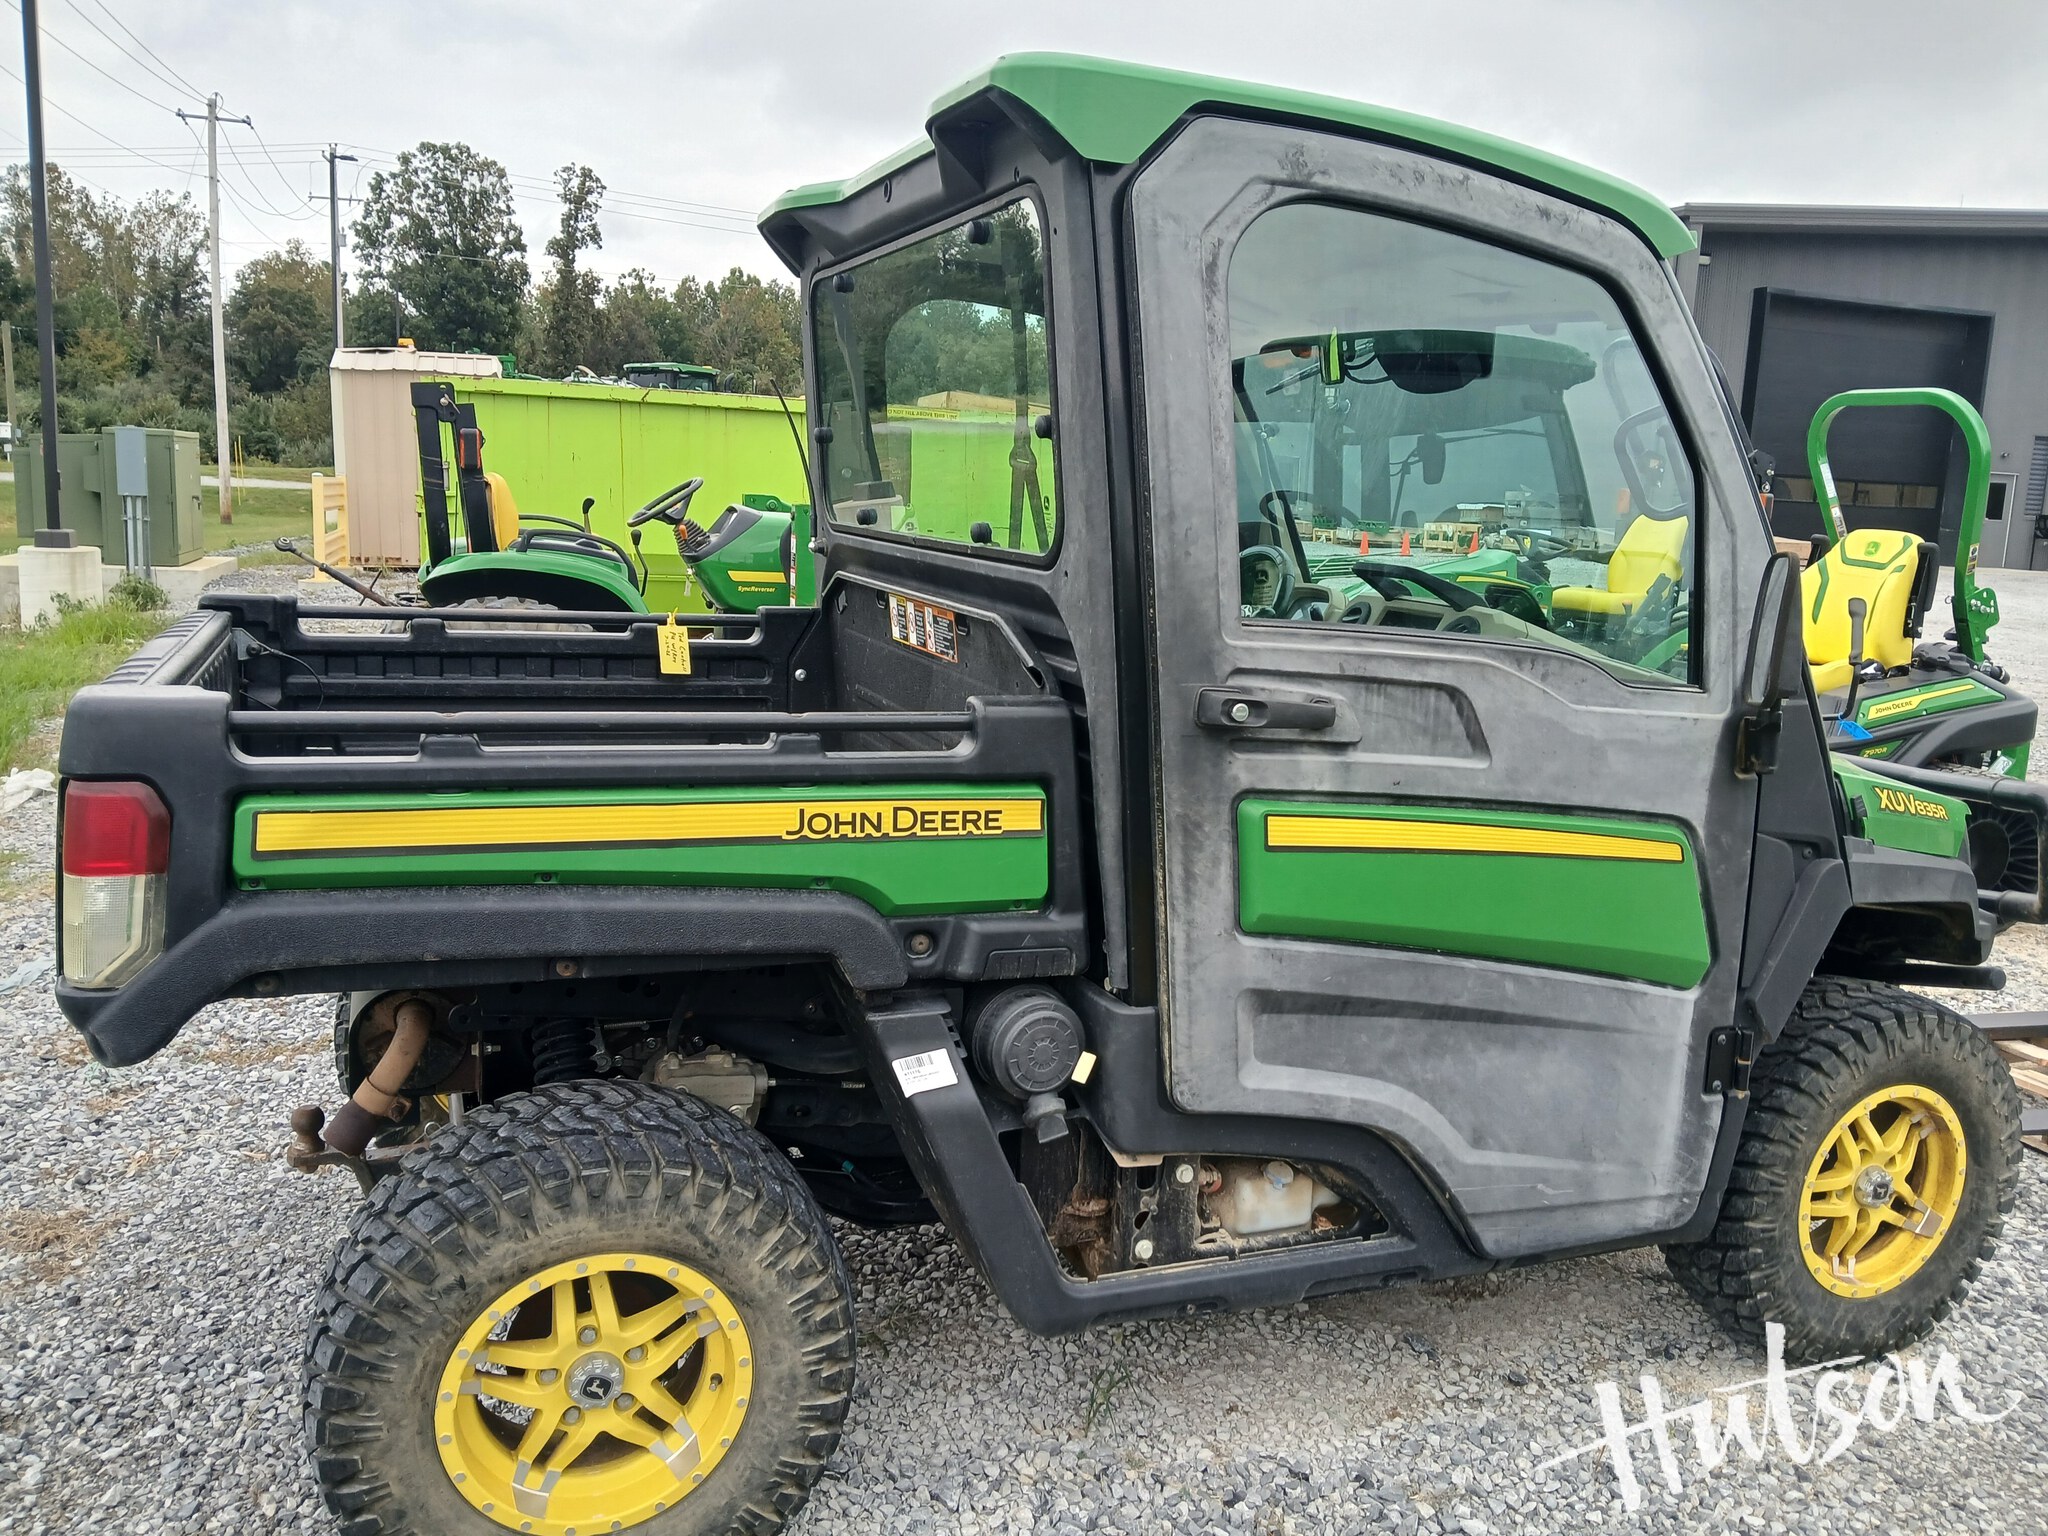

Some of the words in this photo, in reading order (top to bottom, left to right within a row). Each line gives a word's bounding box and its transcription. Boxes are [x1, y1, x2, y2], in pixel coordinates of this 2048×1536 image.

[738, 585, 776, 593] SyncReverser
[1875, 705, 1892, 714] JOHN
[1892, 700, 1913, 710] DEERE
[1863, 747, 1888, 758] Z970R
[1873, 786, 1949, 820] XUV835R
[785, 808, 882, 836] JOHN
[893, 806, 1003, 832] DEERE
